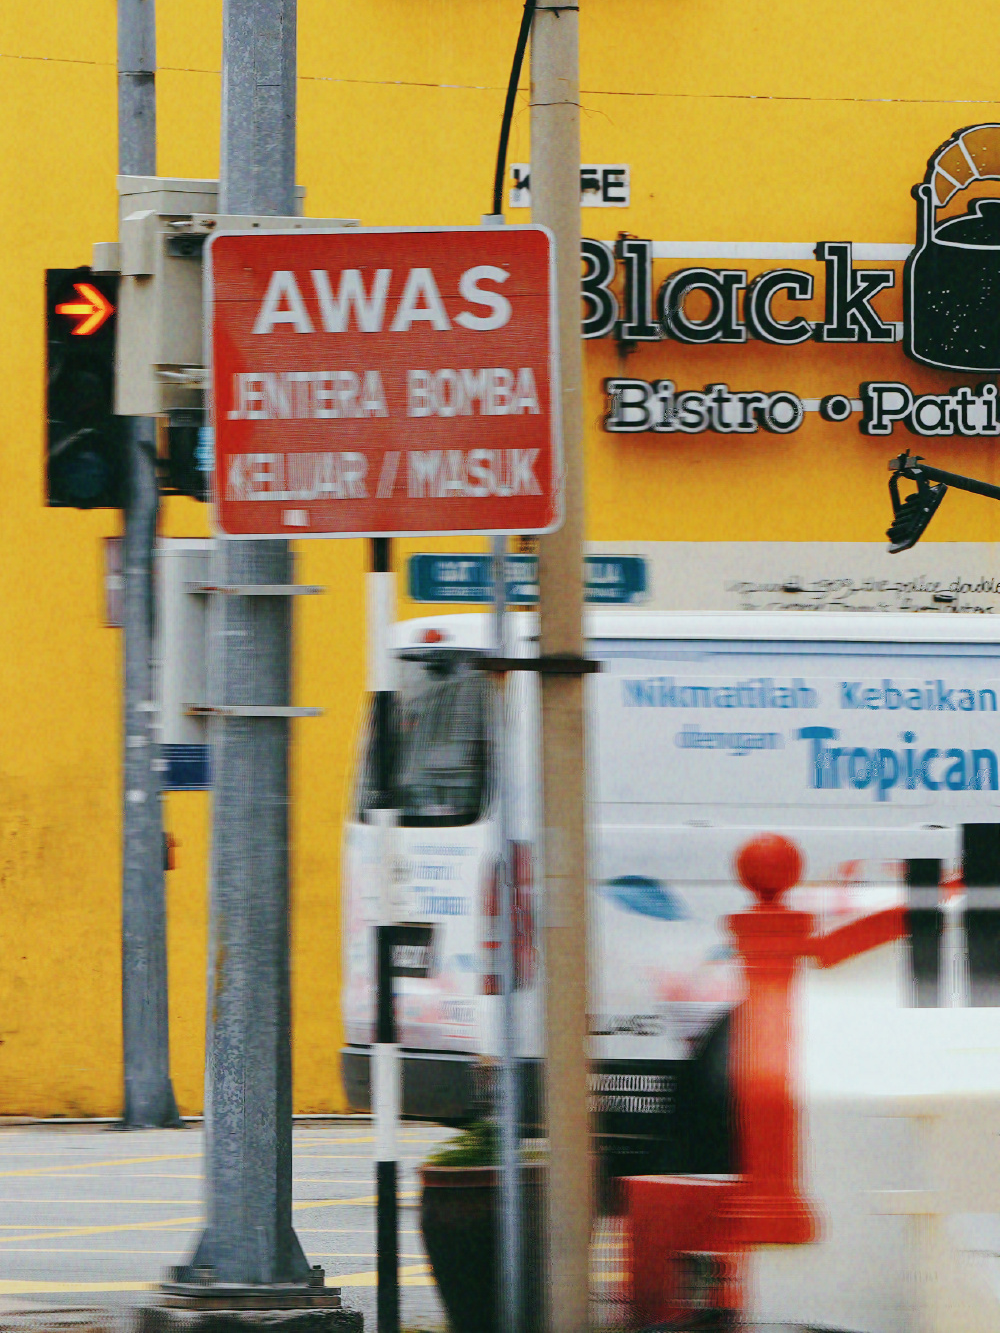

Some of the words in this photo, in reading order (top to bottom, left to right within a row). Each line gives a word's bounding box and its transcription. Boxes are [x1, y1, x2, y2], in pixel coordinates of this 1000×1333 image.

[252, 265, 512, 334] AWAS
[228, 370, 389, 420] JENTERA
[407, 367, 541, 417] BOMBA
[605, 377, 803, 434] Bistro
[225, 451, 370, 501] KELUAR
[407, 448, 543, 498] MASUK
[836, 678, 998, 712] Kebaikan
